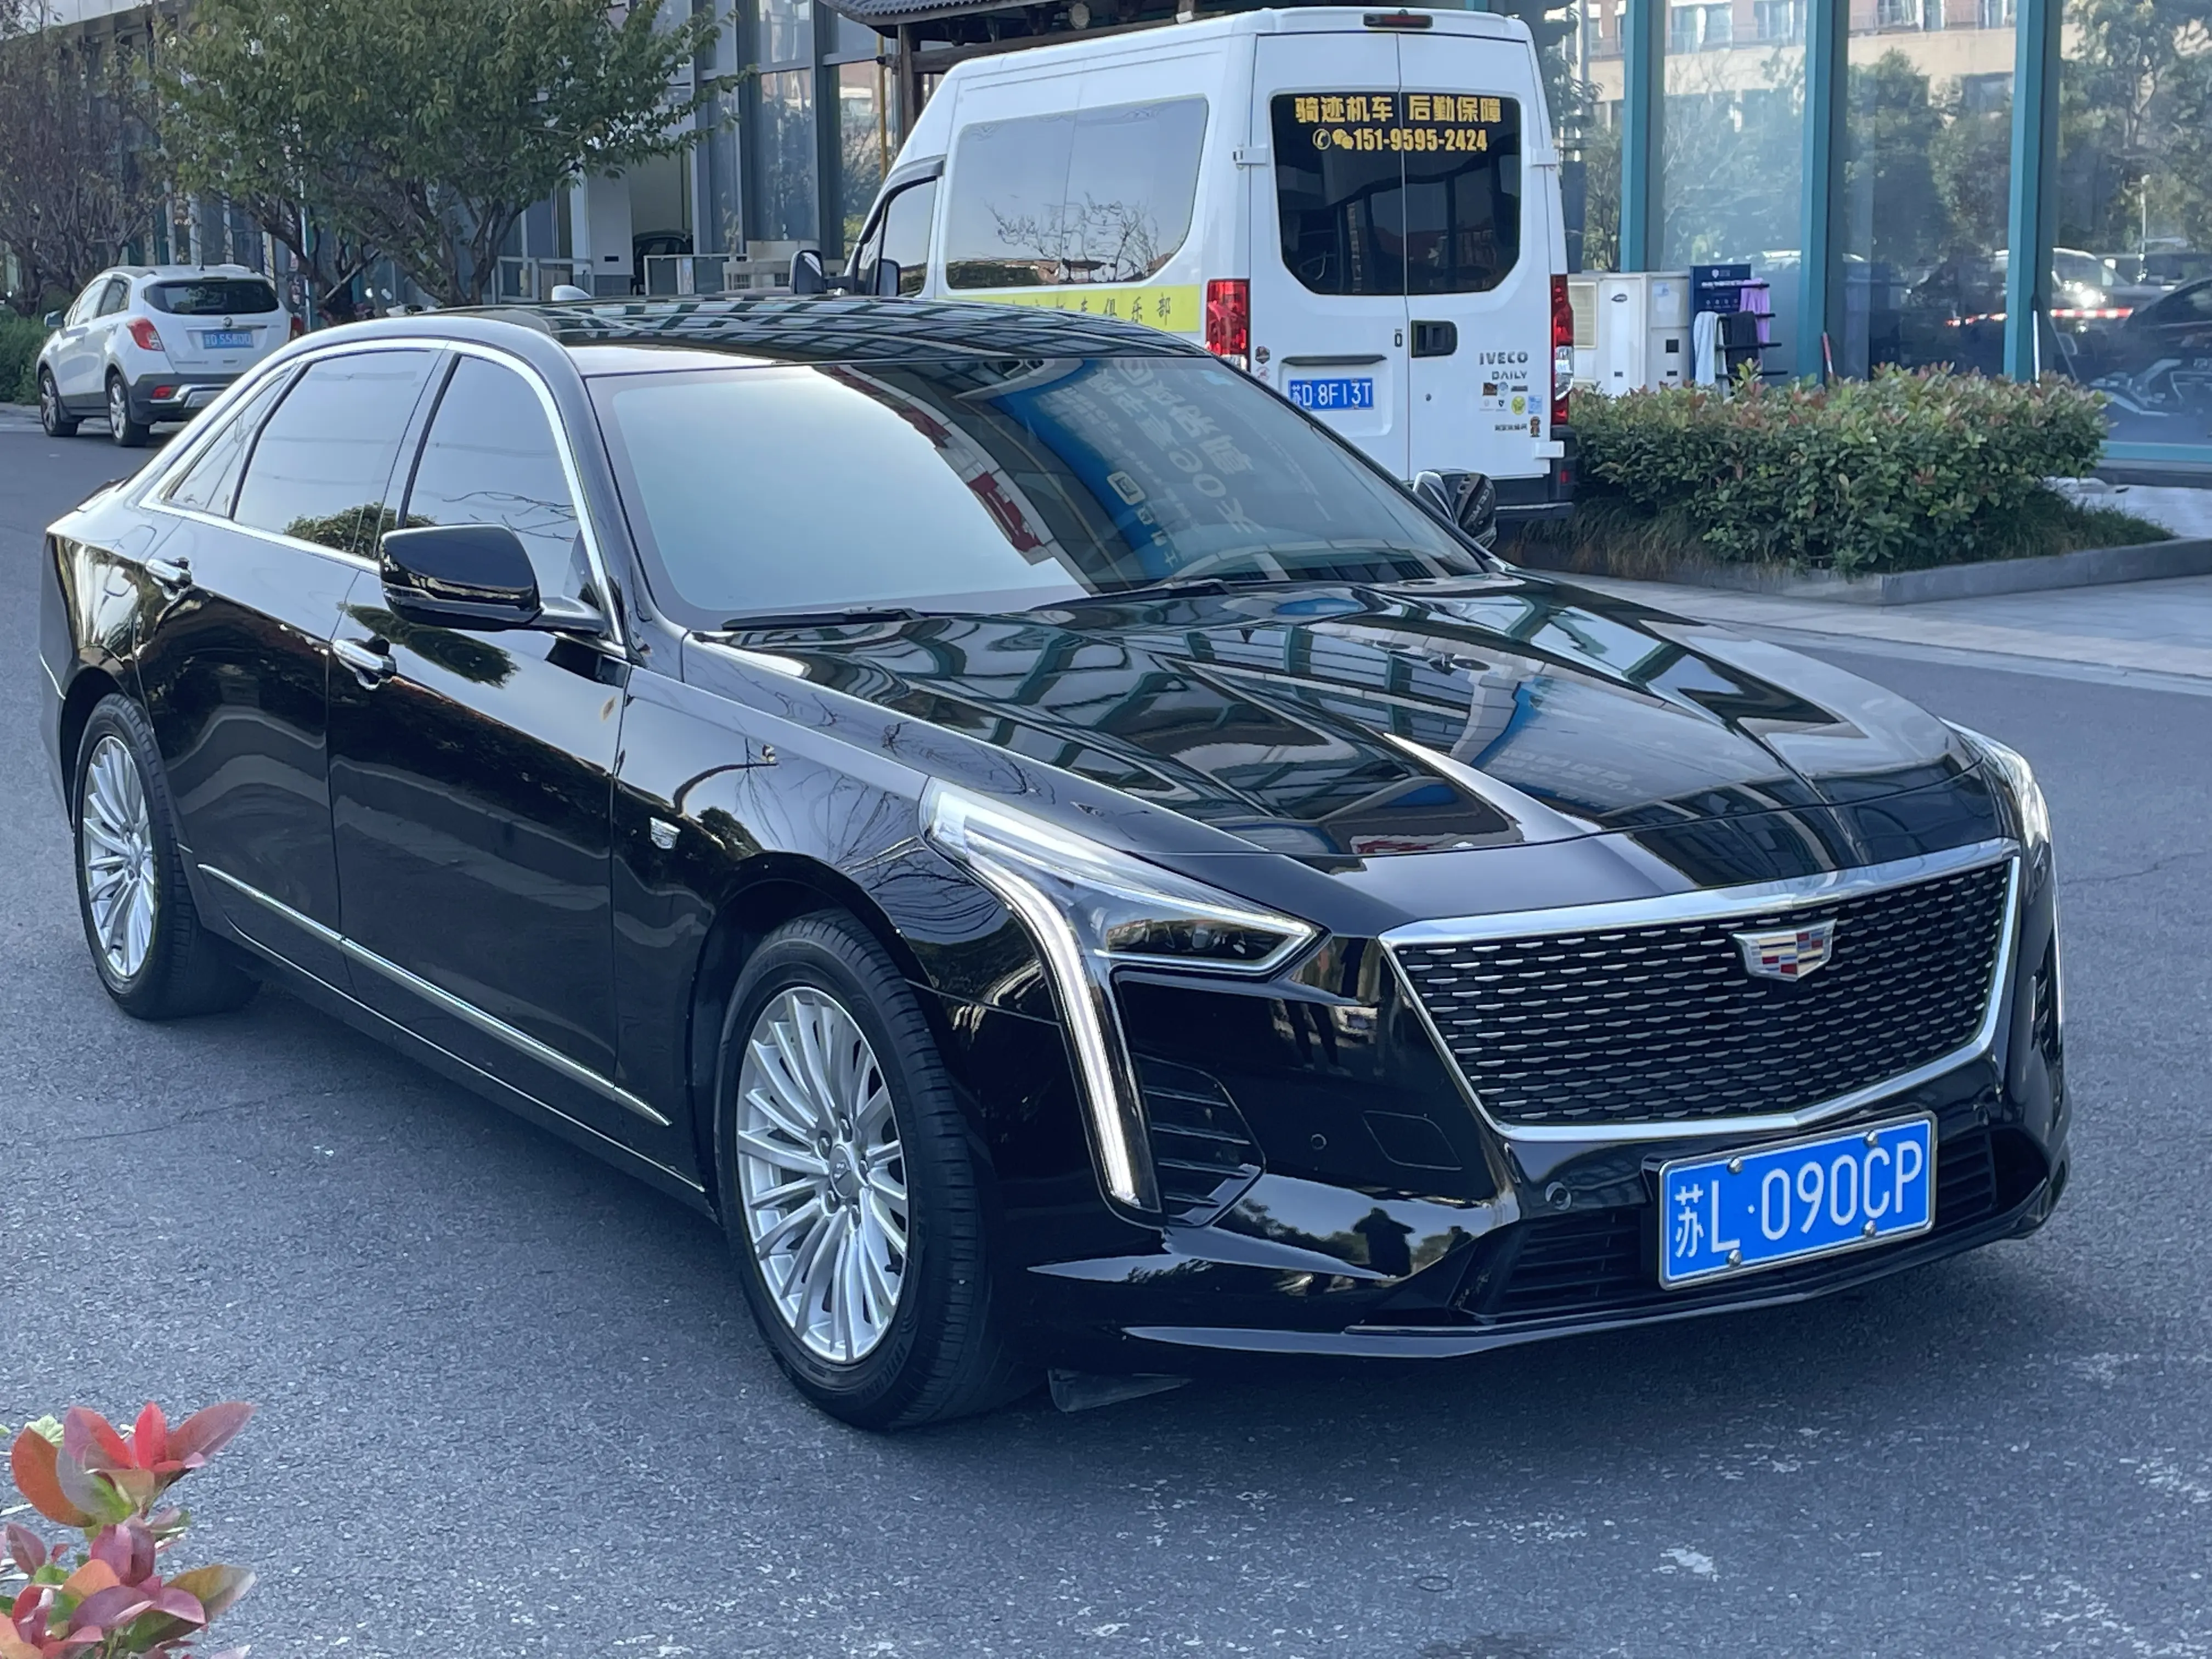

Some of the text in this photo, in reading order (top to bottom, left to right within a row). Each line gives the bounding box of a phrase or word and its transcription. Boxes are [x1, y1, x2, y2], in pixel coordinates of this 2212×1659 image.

[1295, 95, 1502, 123] 骑迹机车 后勤保障
[1353, 128, 1488, 151] 151-9595-2424
[1480, 351, 1528, 365] IVECO
[1492, 370, 1527, 380] DAILY
[1674, 1140, 1923, 1258] 苏L·090CP
